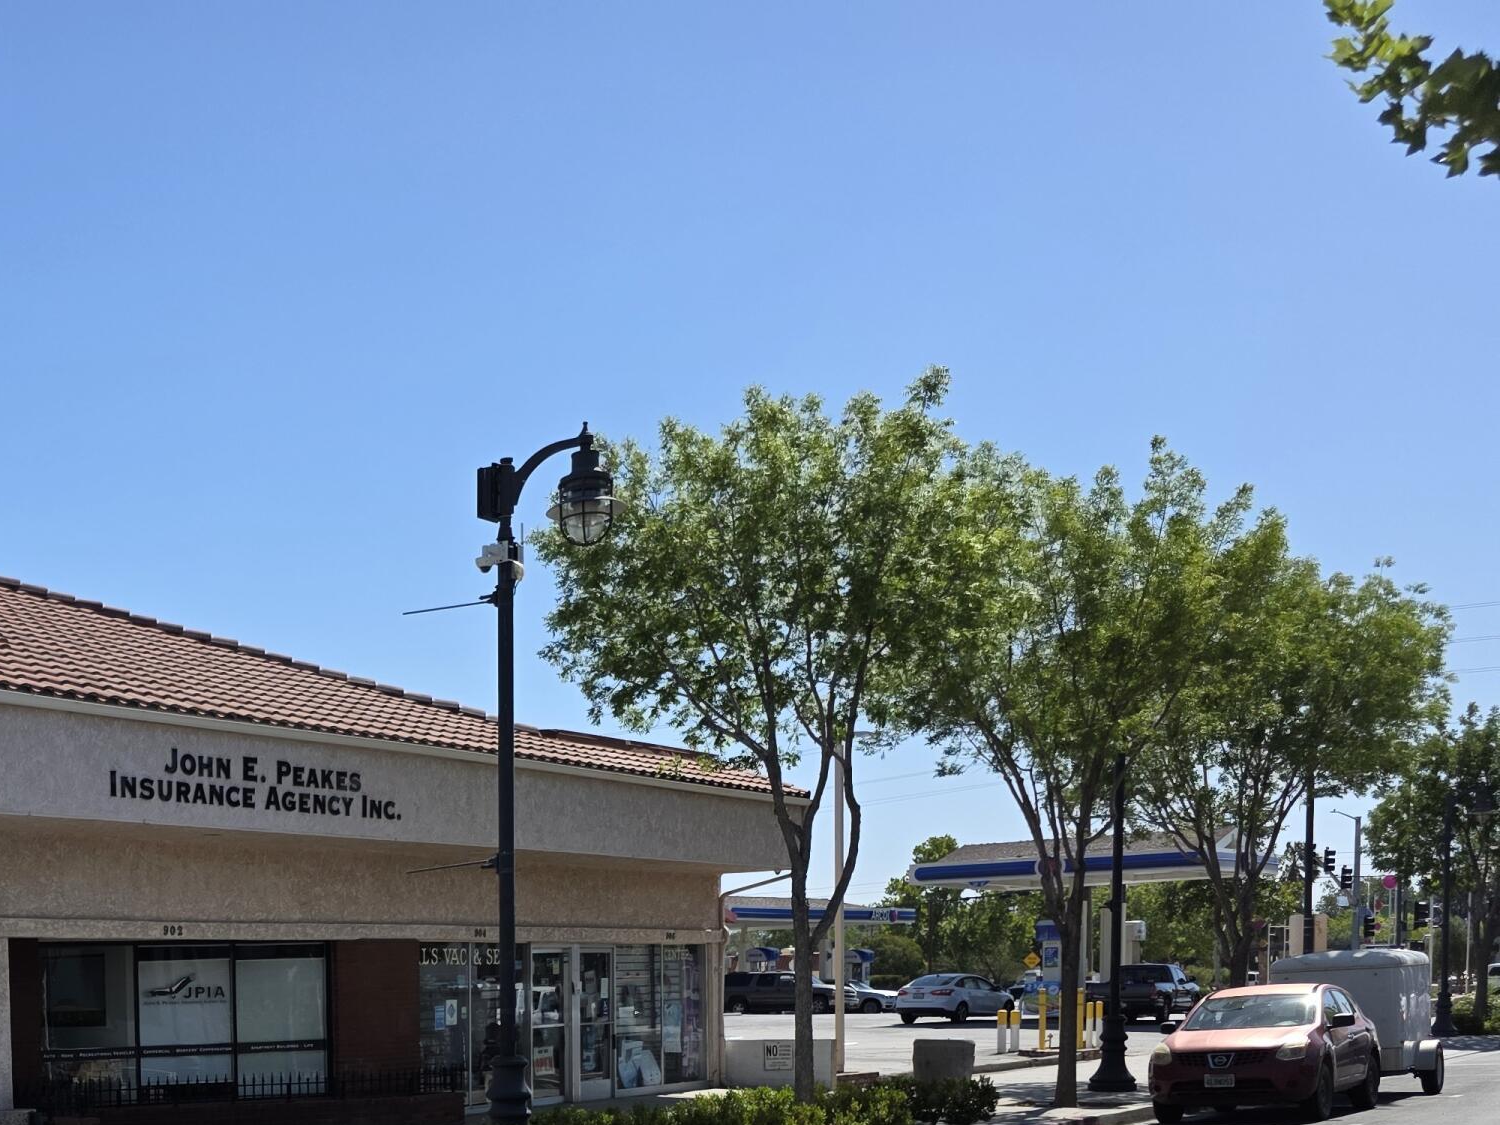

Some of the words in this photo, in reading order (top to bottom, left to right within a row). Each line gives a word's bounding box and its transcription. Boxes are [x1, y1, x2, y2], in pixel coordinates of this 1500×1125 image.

[164, 748, 231, 779] JOHN
[242, 756, 266, 783] E.
[276, 760, 362, 793] PEAKES
[109, 770, 256, 809] INSURANCE
[265, 786, 354, 817] AGENCY
[361, 795, 402, 821] INC.
[163, 925, 183, 937] 902
[443, 948, 467, 966] VAC
[473, 949, 482, 965] &
[183, 986, 225, 999] JPIA
[766, 1045, 777, 1056] NO
